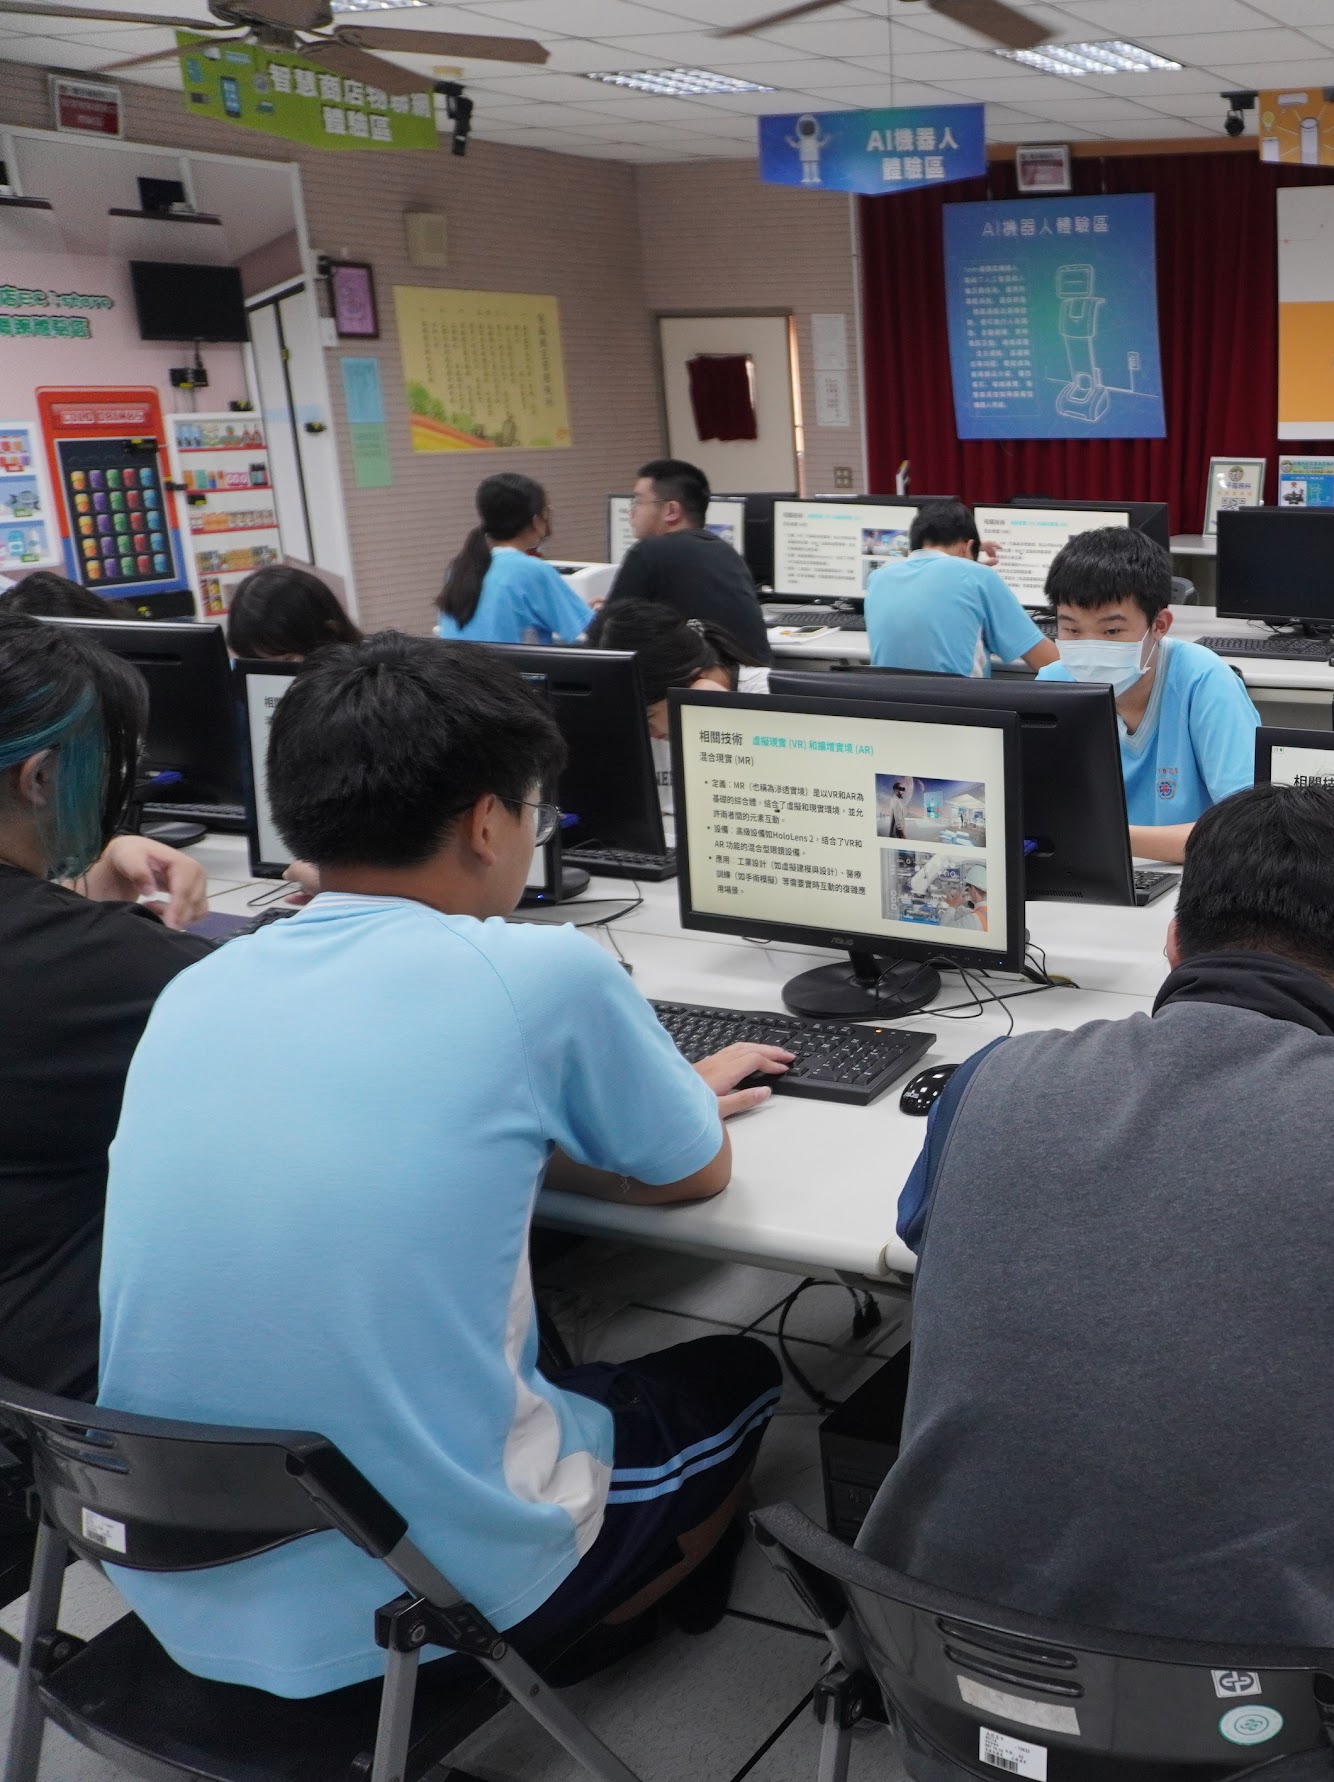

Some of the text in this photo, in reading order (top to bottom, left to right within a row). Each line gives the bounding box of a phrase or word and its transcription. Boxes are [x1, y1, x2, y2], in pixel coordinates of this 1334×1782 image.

[323, 106, 392, 141] 體驗區
[866, 127, 959, 152] AI機器人
[882, 156, 945, 181] 體驗區
[981, 215, 1109, 237] AI機器人體驗區
[699, 730, 743, 746] 相關技術
[788, 740, 807, 751] (VR)
[855, 745, 874, 756] (AR)
[699, 751, 754, 767] 混合現實 (MR)
[714, 841, 724, 849] AR
